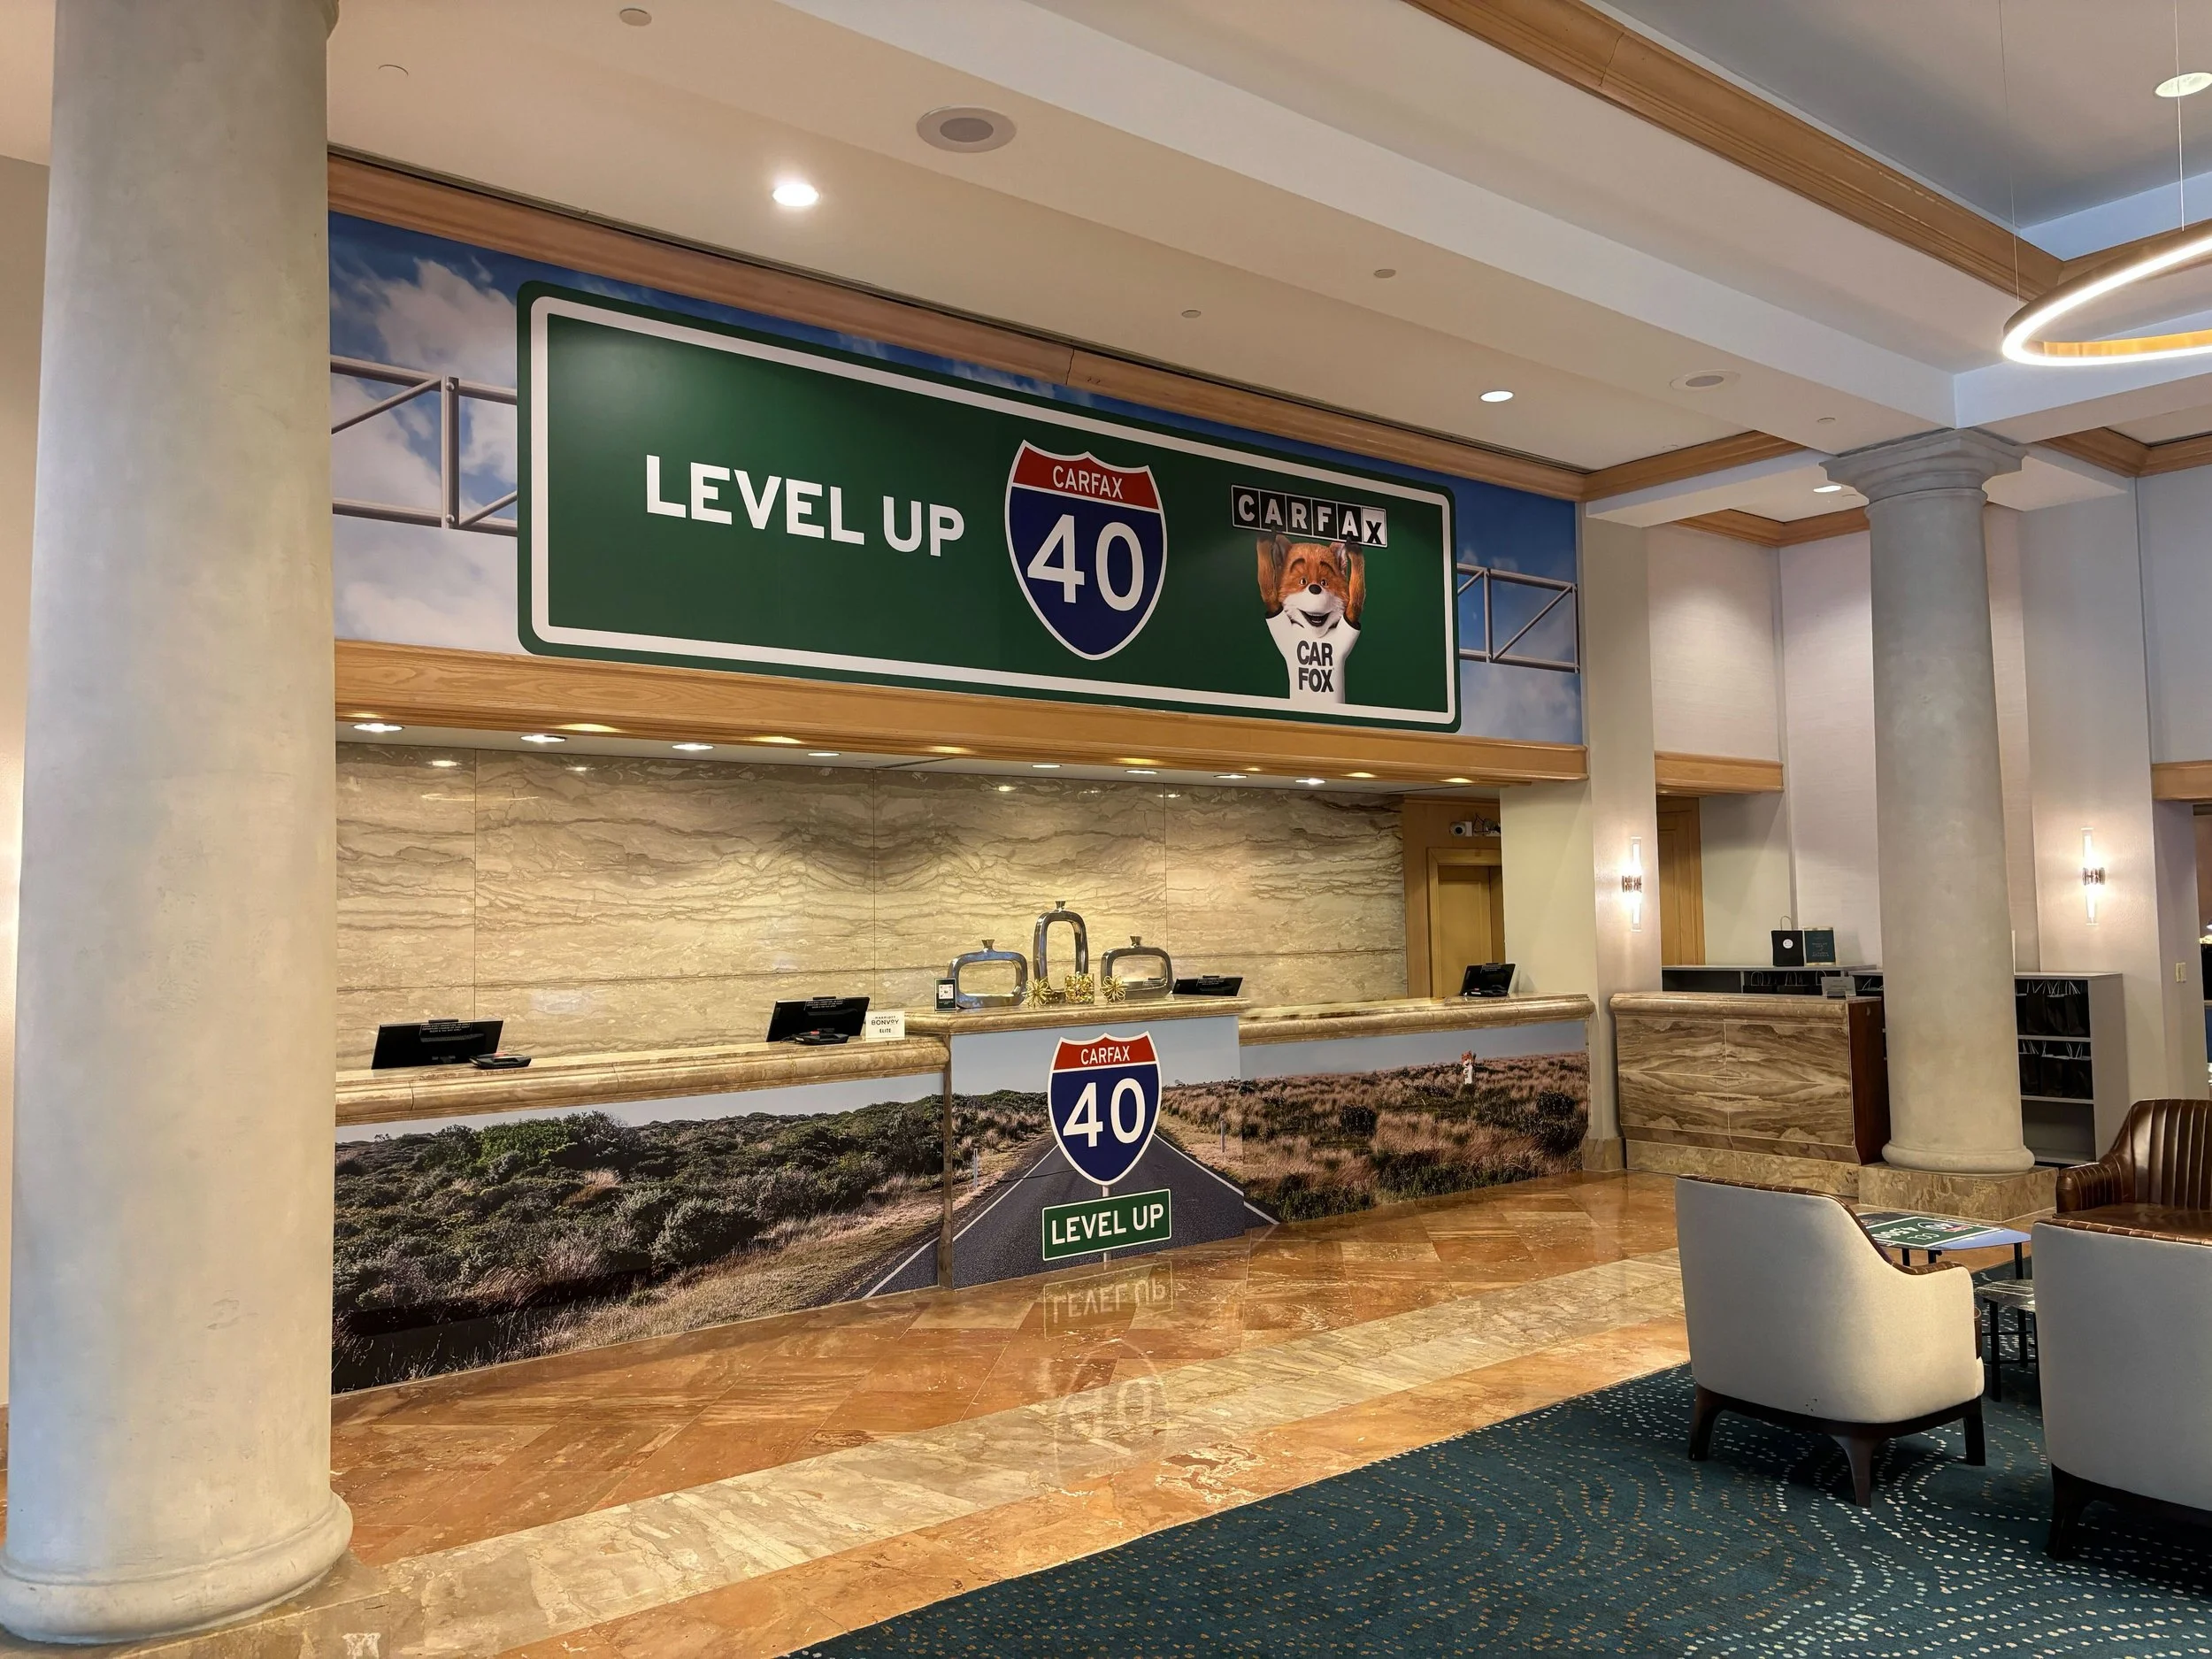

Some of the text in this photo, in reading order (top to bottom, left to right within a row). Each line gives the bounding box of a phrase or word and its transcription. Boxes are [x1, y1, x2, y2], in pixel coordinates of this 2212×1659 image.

[1053, 465, 1124, 500] CARFAX
[647, 454, 964, 557] LEVEL UP
[1238, 494, 1383, 545] CARFAX
[1027, 514, 1145, 611] 40
[1296, 640, 1333, 666] CAR
[1298, 666, 1334, 693] FOX
[1080, 1045, 1131, 1065] CARFAX
[1063, 1078, 1146, 1148] 40
[1051, 1203, 1164, 1245] LEVEL UP
